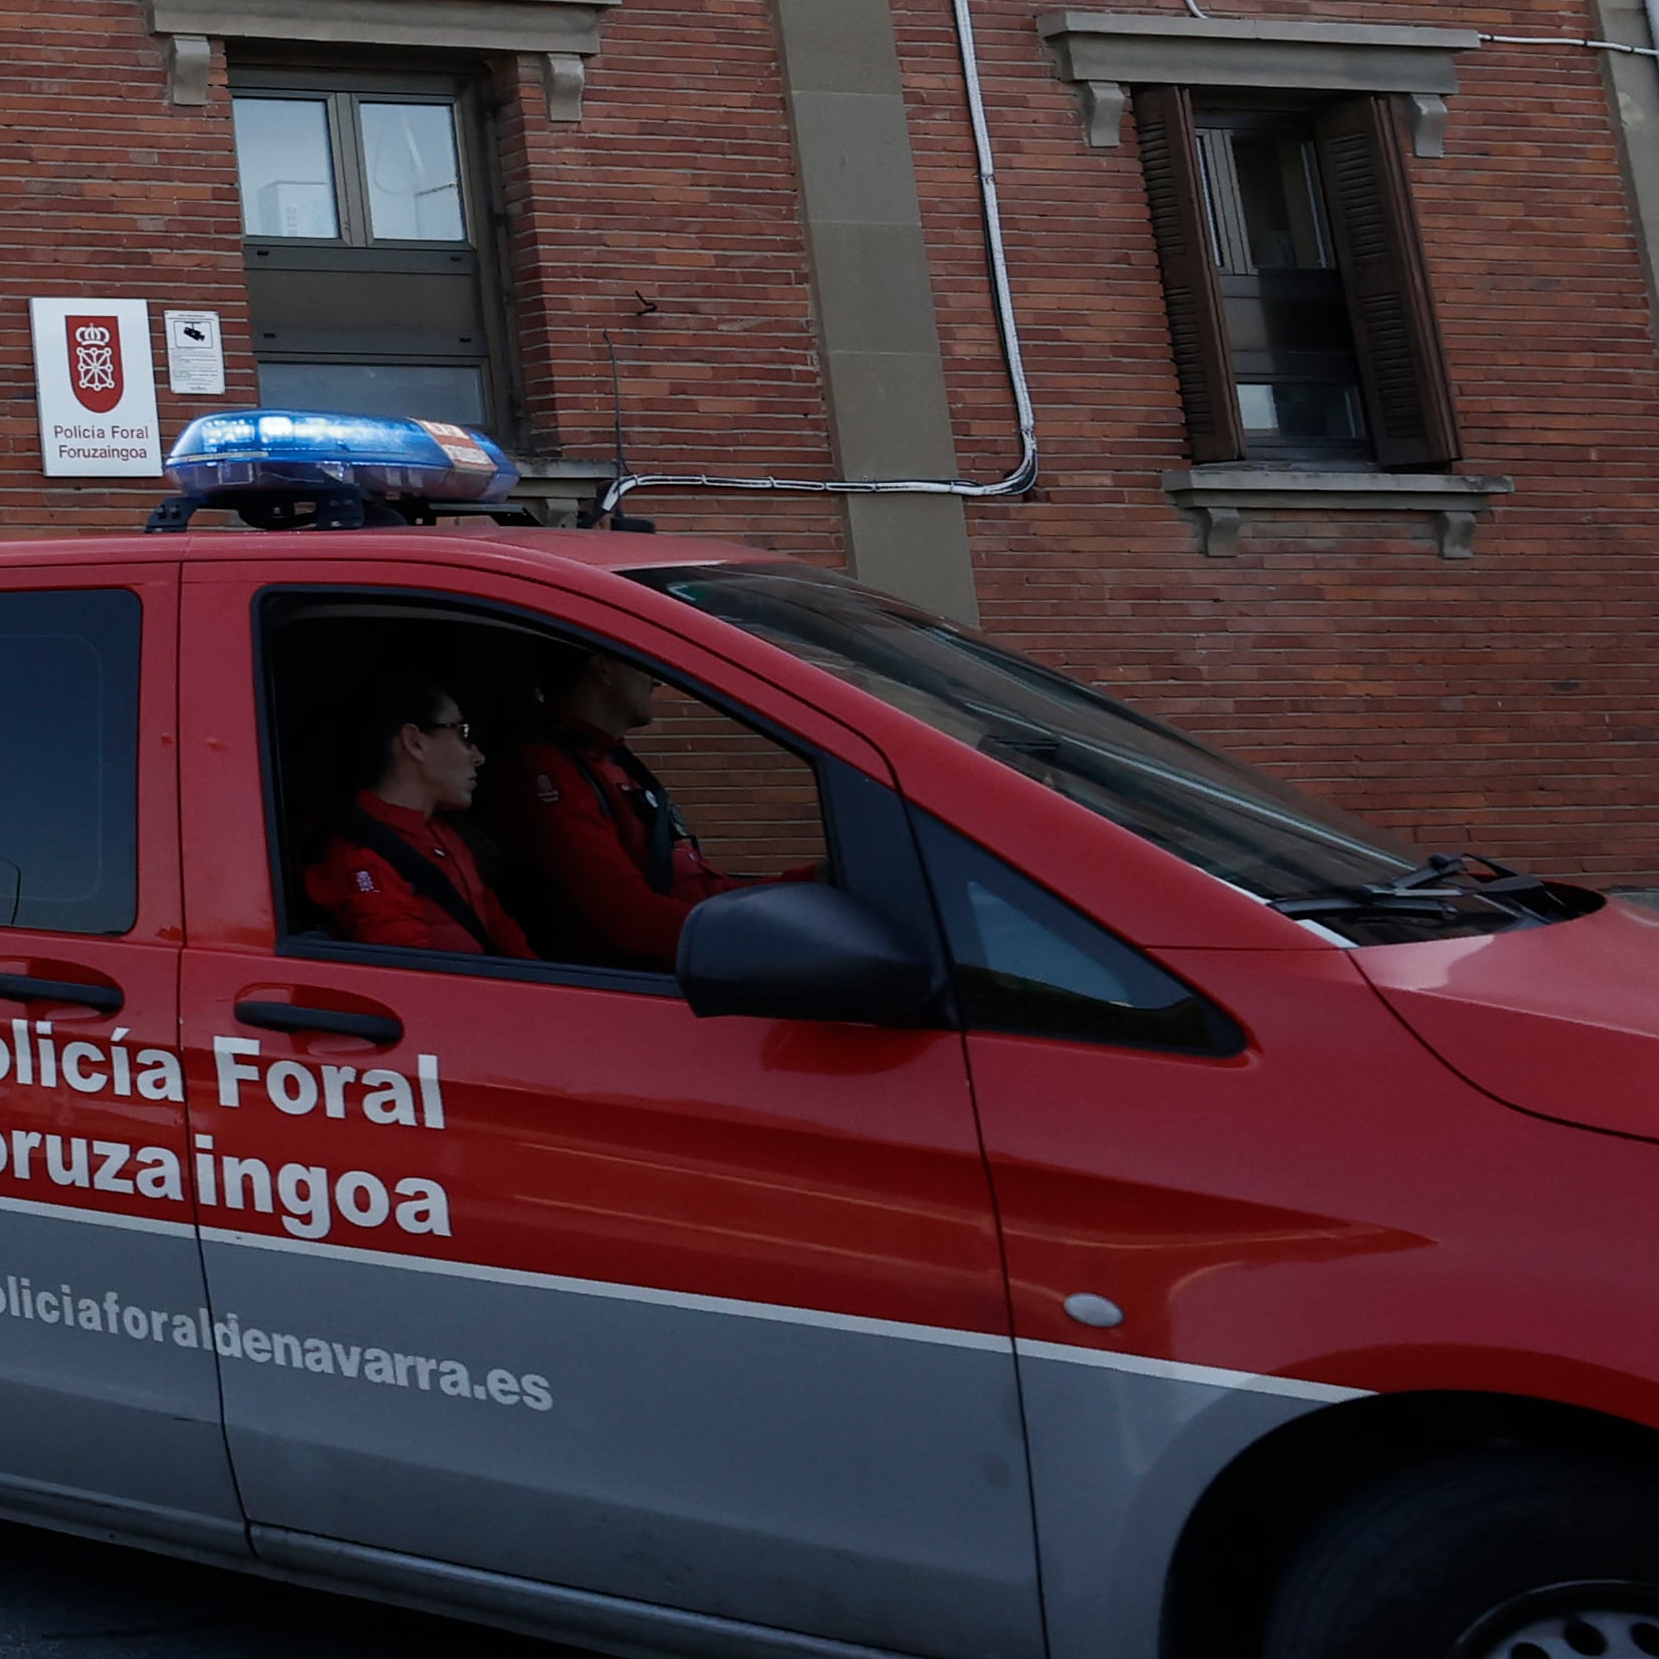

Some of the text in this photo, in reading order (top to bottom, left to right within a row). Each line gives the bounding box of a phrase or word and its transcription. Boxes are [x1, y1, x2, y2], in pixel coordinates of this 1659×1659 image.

[111, 425, 149, 441] Foral
[58, 443, 148, 461] Foruzaingoa
[215, 1035, 446, 1130] Foral
